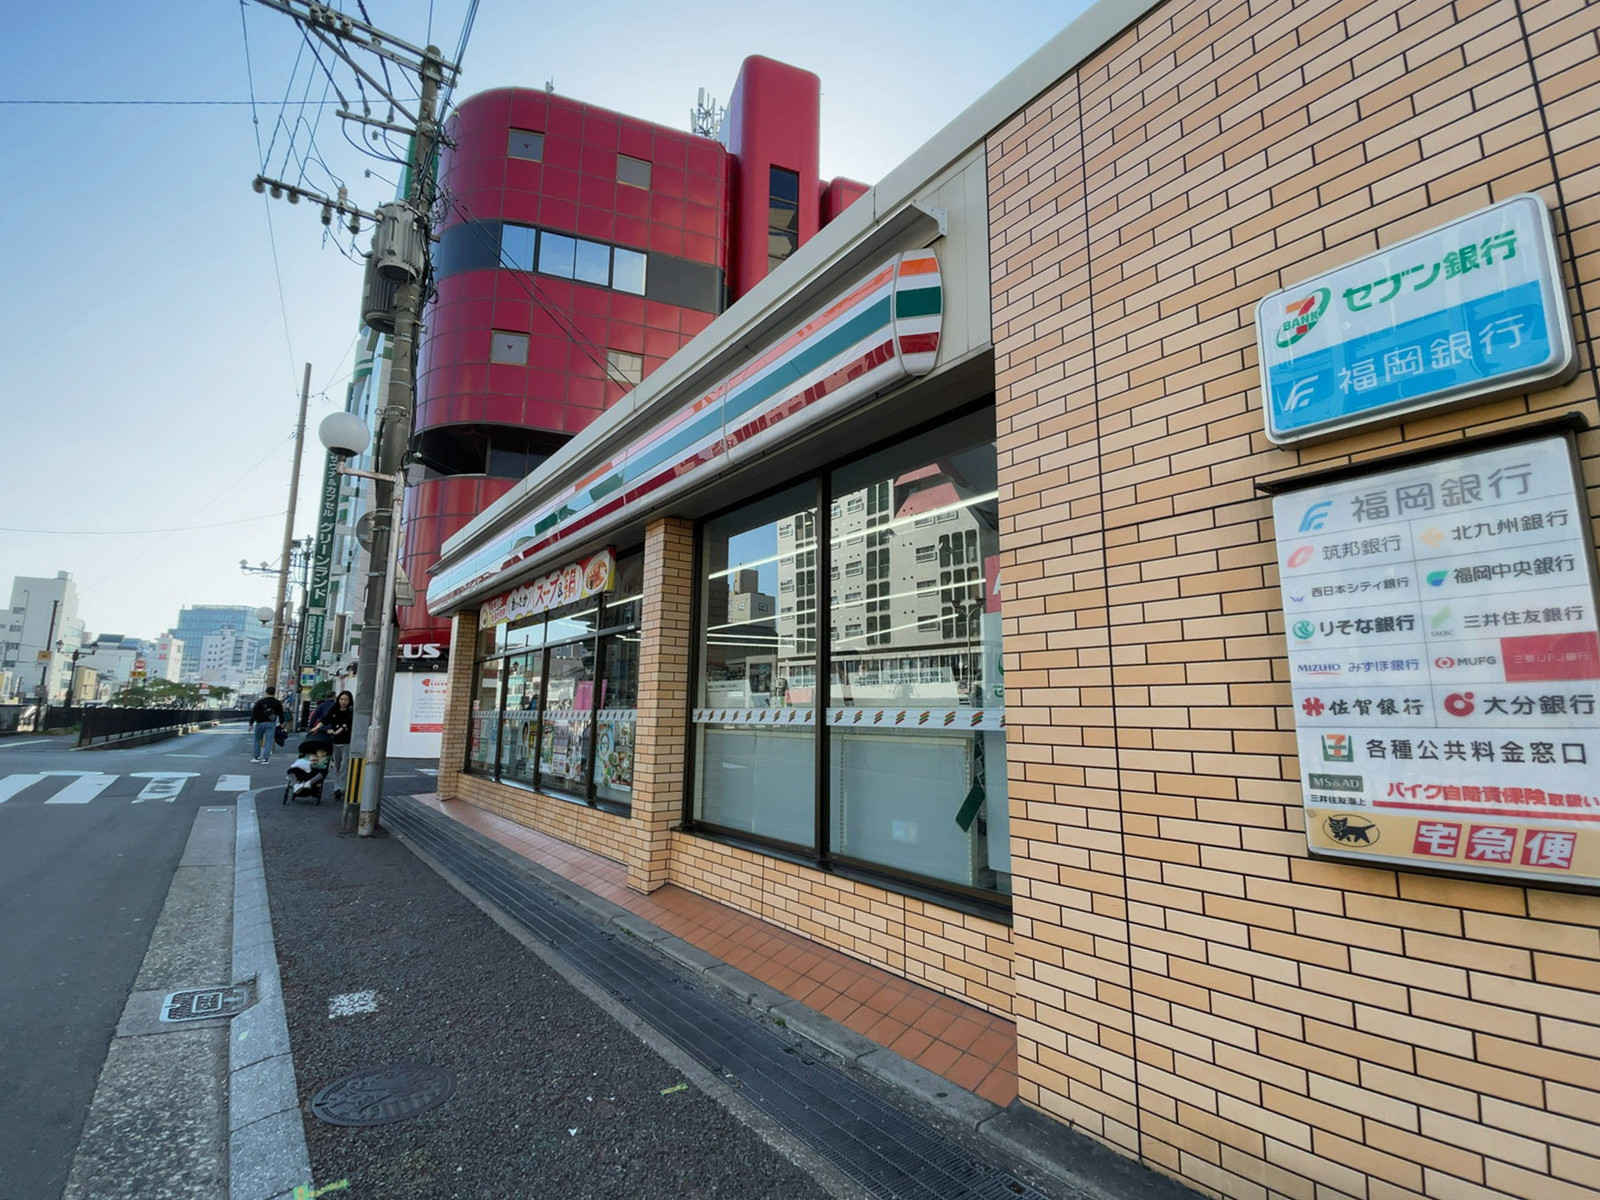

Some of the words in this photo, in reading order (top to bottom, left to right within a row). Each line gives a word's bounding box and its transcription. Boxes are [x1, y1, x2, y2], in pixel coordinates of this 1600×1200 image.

[1343, 229, 1517, 313] セブン銀行
[1283, 311, 1319, 331] BANK
[1338, 314, 1525, 395] 福岡銀行
[1350, 462, 1532, 522] 福岡銀行
[1451, 508, 1569, 541] 北九州銀行
[1322, 535, 1401, 561] 筑邦銀行
[313, 521, 335, 600] グリーンランド
[1453, 554, 1575, 584] 福岡中央銀行
[1311, 576, 1409, 598] 西日本シティ銀行
[1319, 614, 1415, 637] りそな銀行
[1463, 605, 1584, 629] 三井住友銀行
[398, 643, 440, 659] US
[1457, 655, 1497, 666] MUFG
[1297, 663, 1341, 673] MIZUHO
[1348, 659, 1420, 673] みずほ銀行
[1328, 698, 1424, 716] 佐賀銀行
[1483, 694, 1596, 716] 大分銀行
[1365, 738, 1587, 765] 各種公共料金窓口
[1313, 777, 1360, 788] MS&AD
[1310, 794, 1366, 806] 三井住友海上
[1417, 823, 1575, 867] 宅急便
